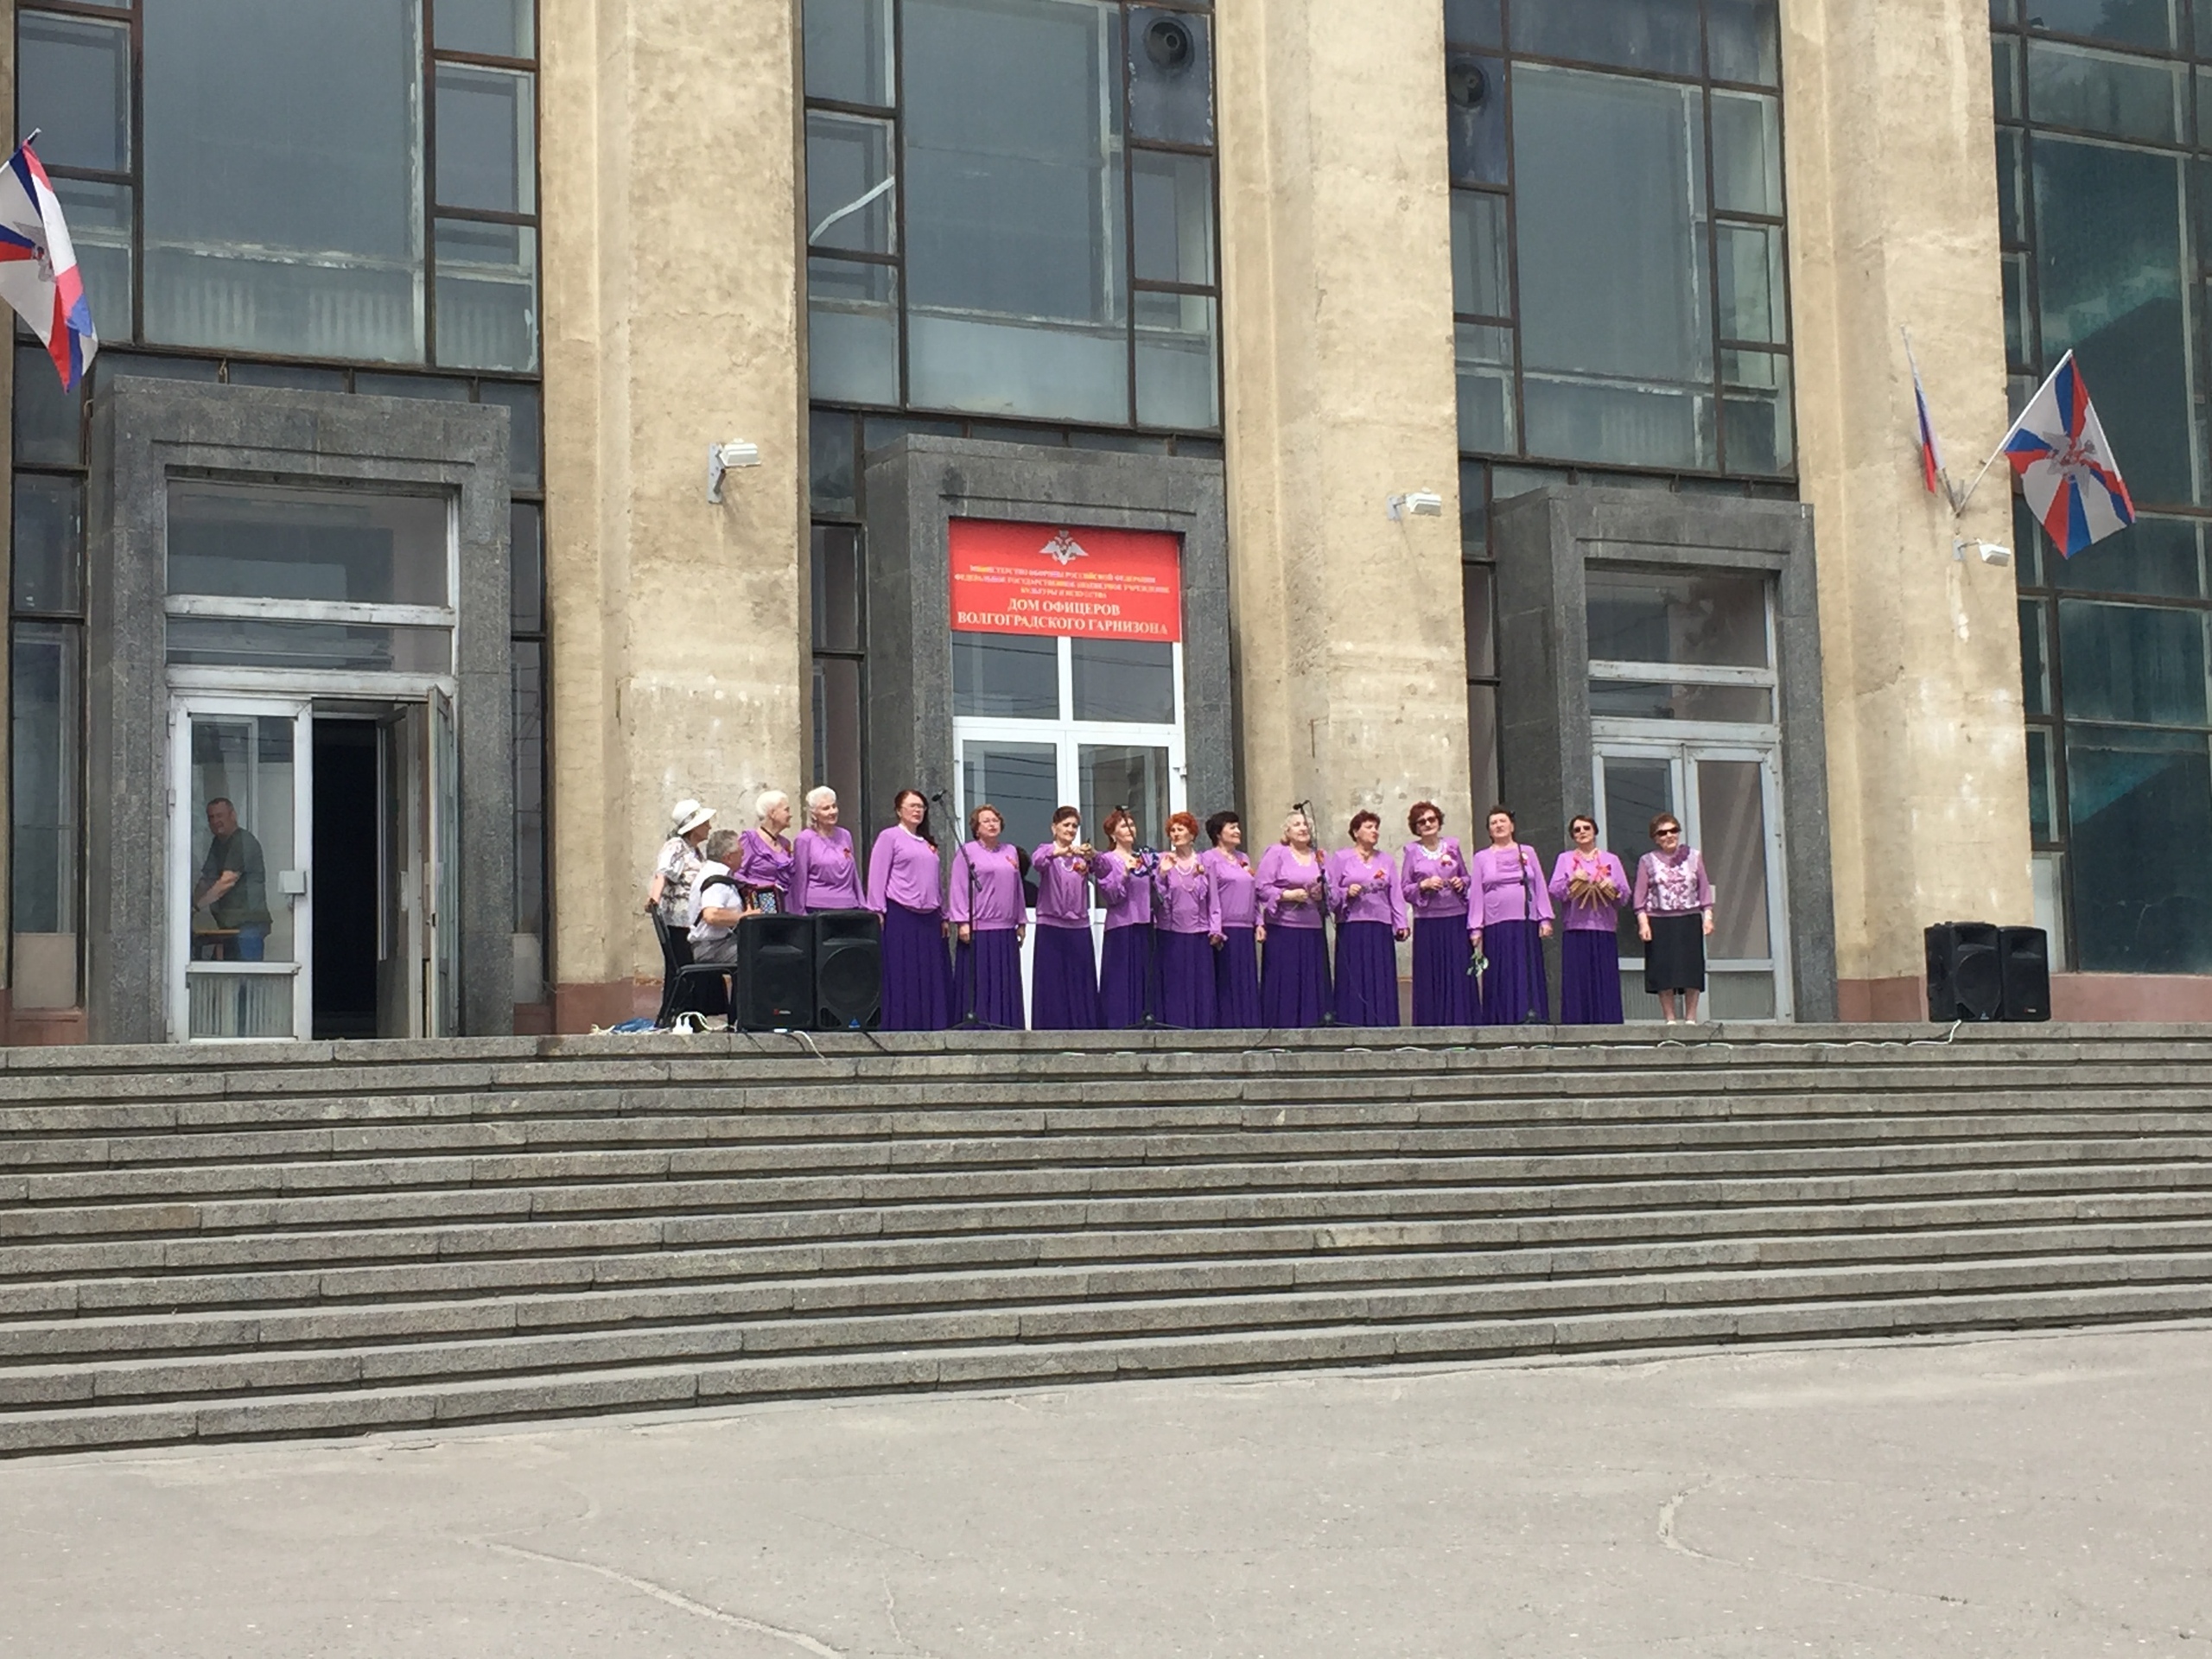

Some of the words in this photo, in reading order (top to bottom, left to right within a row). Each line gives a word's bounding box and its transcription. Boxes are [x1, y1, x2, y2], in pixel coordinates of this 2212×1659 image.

[1007, 598, 1039, 612] ДОМ
[1042, 601, 1121, 616] ОФИЦЕРОВ
[957, 611, 1085, 630] ВОЛГОГРАДСКОГО
[1089, 618, 1168, 634] ГАРНИЗОНА
